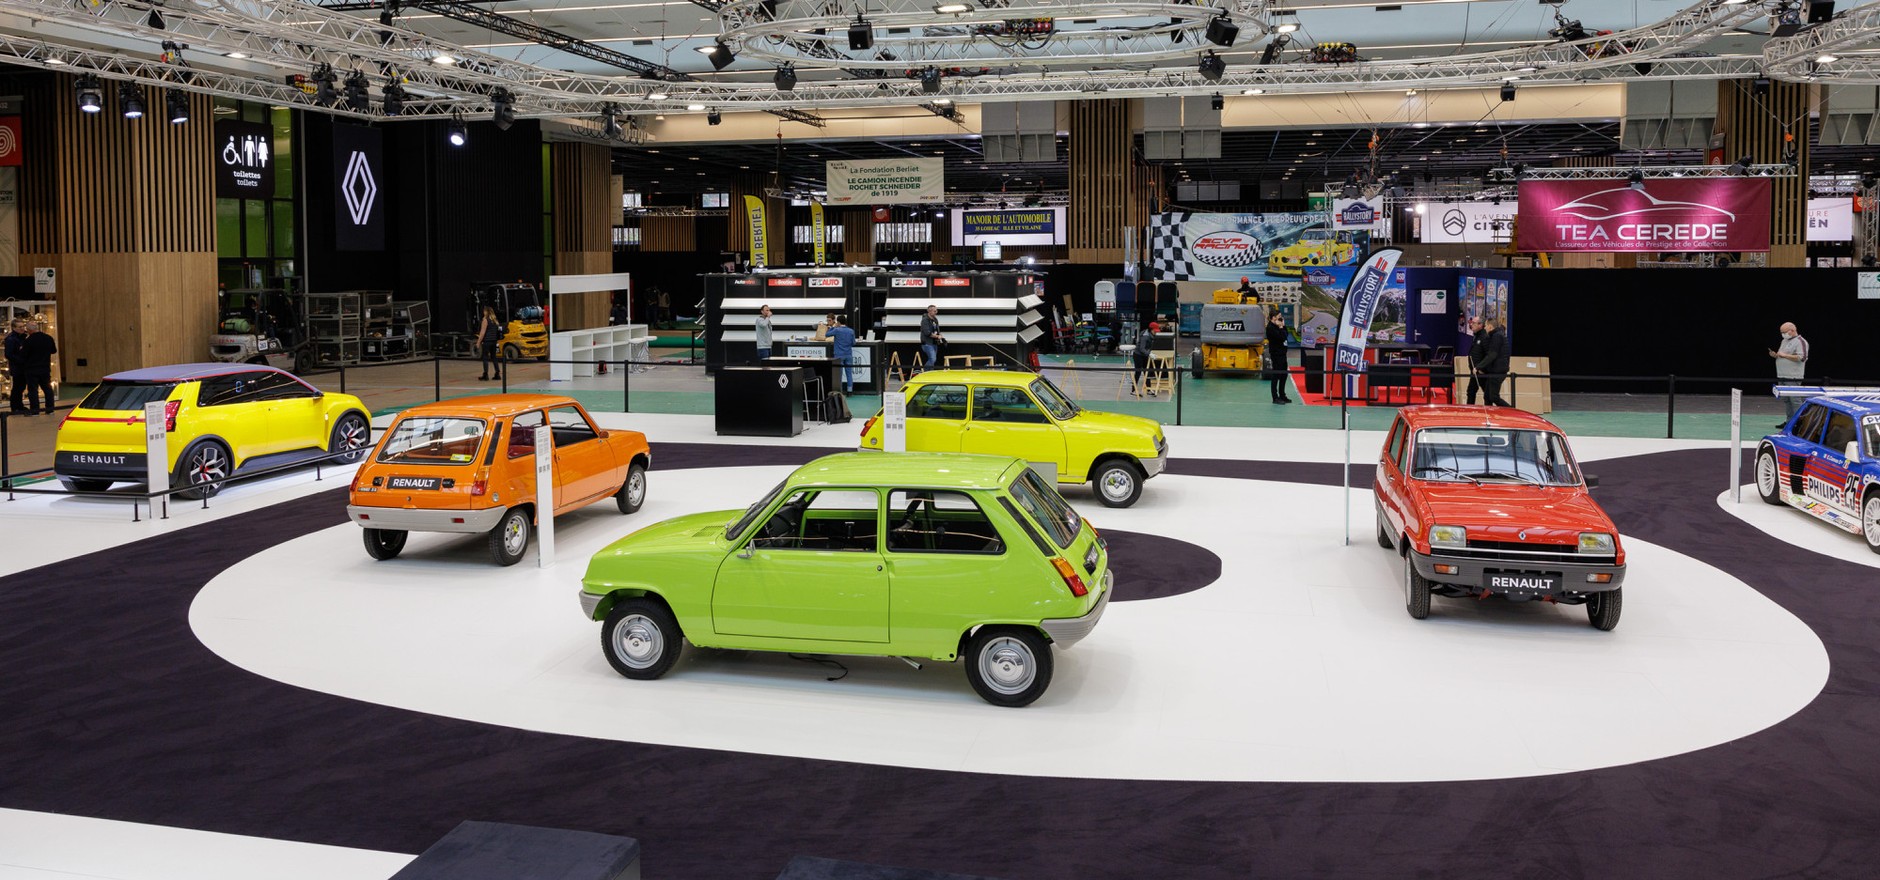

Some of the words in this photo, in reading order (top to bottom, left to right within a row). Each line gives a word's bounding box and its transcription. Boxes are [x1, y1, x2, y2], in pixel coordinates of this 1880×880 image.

[233, 170, 261, 179] toilettes
[966, 215, 993, 224] MANOIR
[993, 215, 1001, 224] DE
[1003, 214, 1051, 224] L'AUTOMOBILE
[1343, 211, 1372, 220] RALLYSTORY
[1809, 217, 1828, 228] ËN
[1556, 224, 1609, 240] TEA
[1617, 224, 1727, 240] CEREDE
[1353, 271, 1380, 324] RALLYSTORY
[1216, 323, 1242, 331] SALTI
[1340, 350, 1358, 366] RSO
[72, 454, 126, 465] RENAULT
[393, 478, 435, 488] RENAULT
[1808, 477, 1840, 503] PHILIPS
[1844, 473, 1860, 512] 25
[1492, 576, 1554, 589] RENAULT
